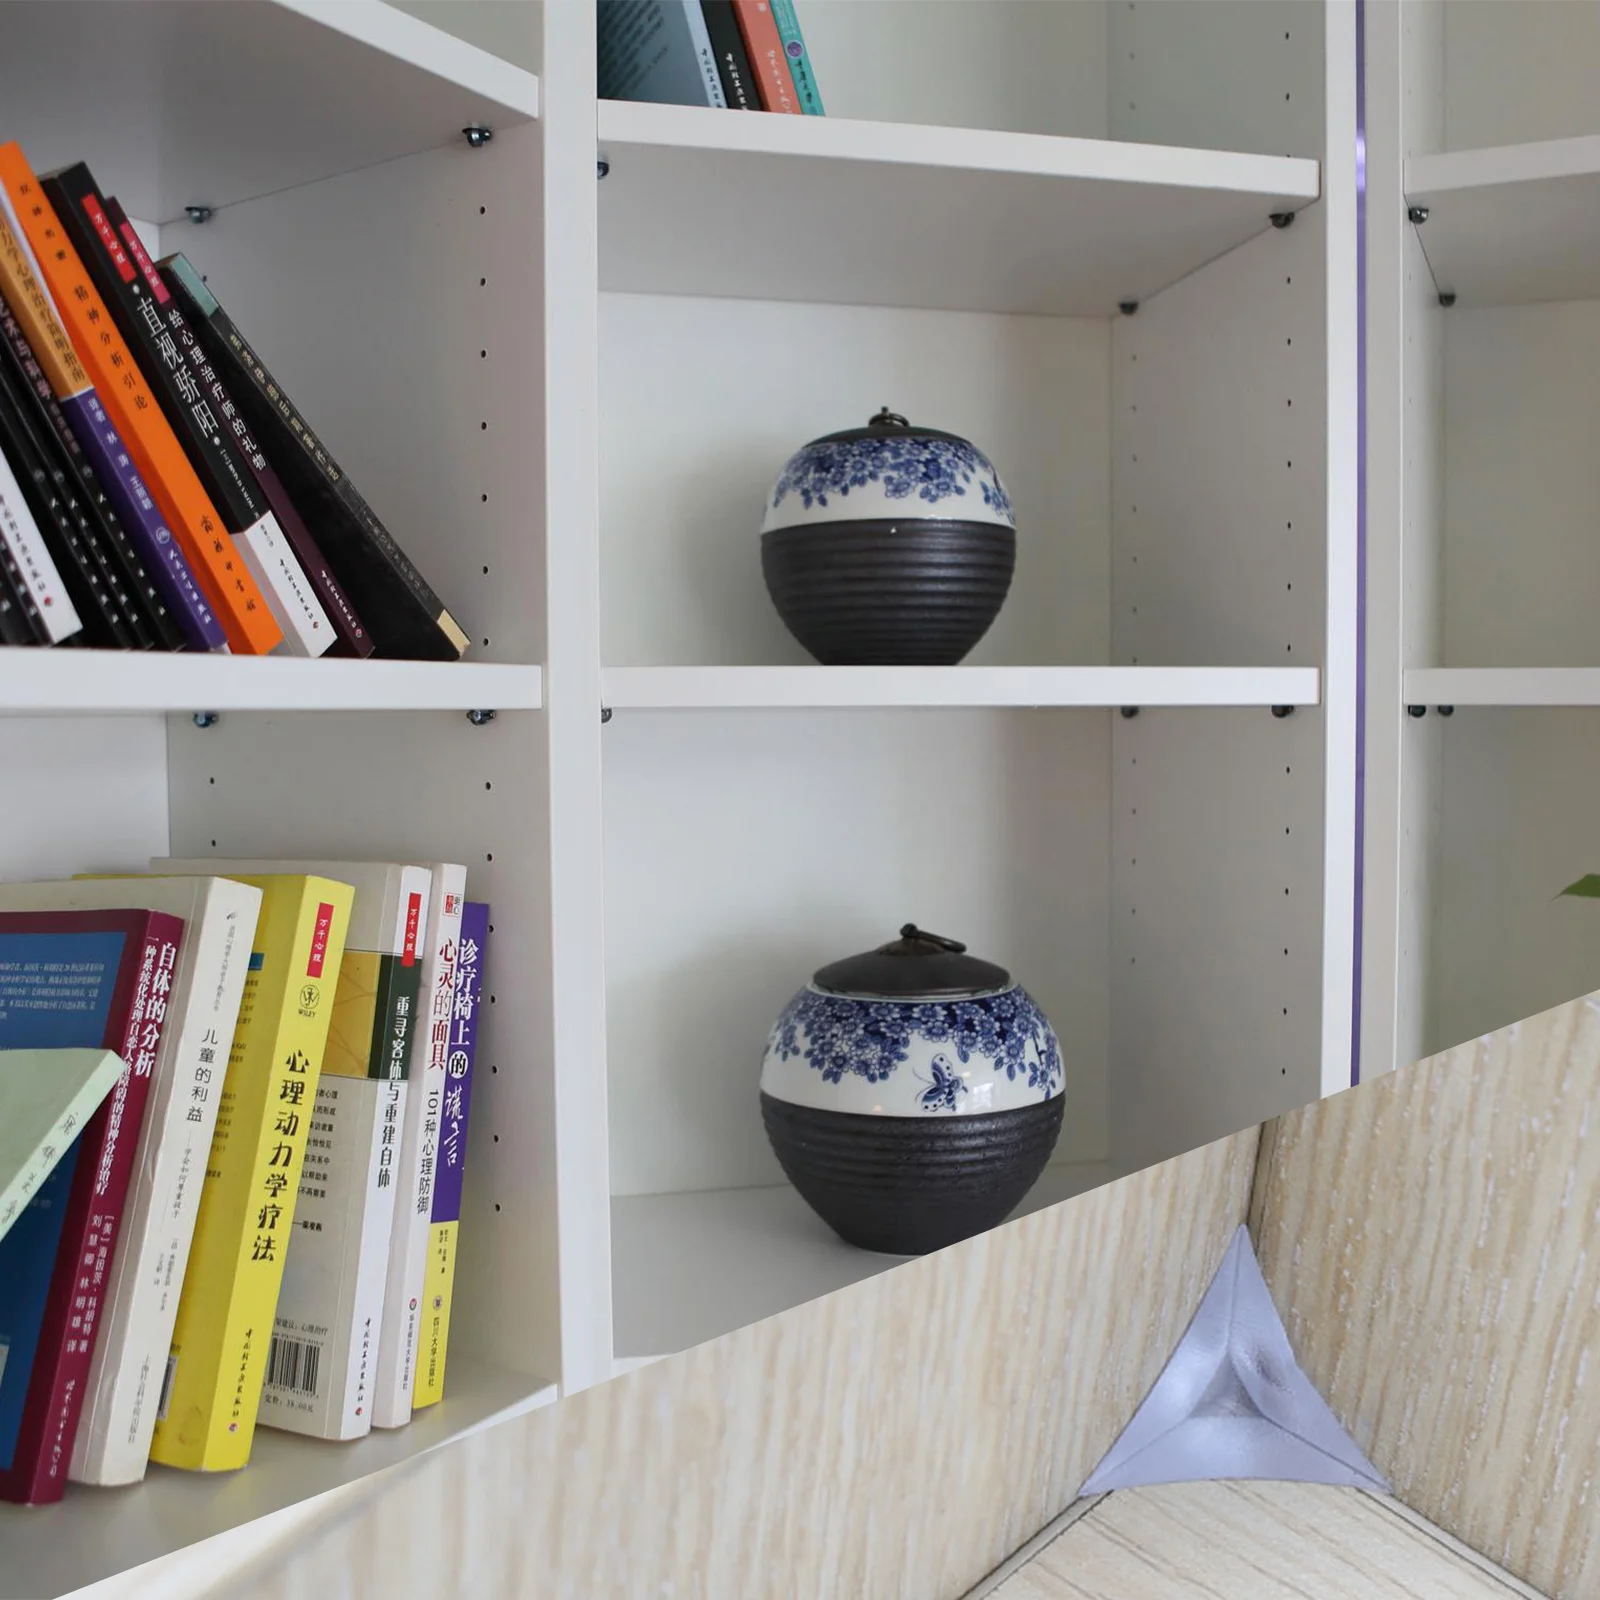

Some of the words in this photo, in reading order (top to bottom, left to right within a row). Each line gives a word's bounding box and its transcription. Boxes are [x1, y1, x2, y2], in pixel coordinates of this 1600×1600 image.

[74, 284, 149, 411] 精神分析引论
[137, 297, 219, 438] 直视骄阳
[168, 310, 267, 471] 给心理治疗师的礼物
[312, 918, 328, 963] 万千心理
[406, 908, 418, 952] 万千心理
[135, 942, 177, 1078] 自体的分析
[297, 1008, 316, 1019] WILEY
[428, 938, 457, 1072] 心灵的面具
[186, 1028, 219, 1123] 儿童的利益
[377, 995, 411, 1189] 重寻客体与重建自体
[251, 1049, 310, 1262] 心理动力学疗法
[417, 1090, 439, 1215] 101种心理防御
[428, 1316, 440, 1388] 四川大学出版社
